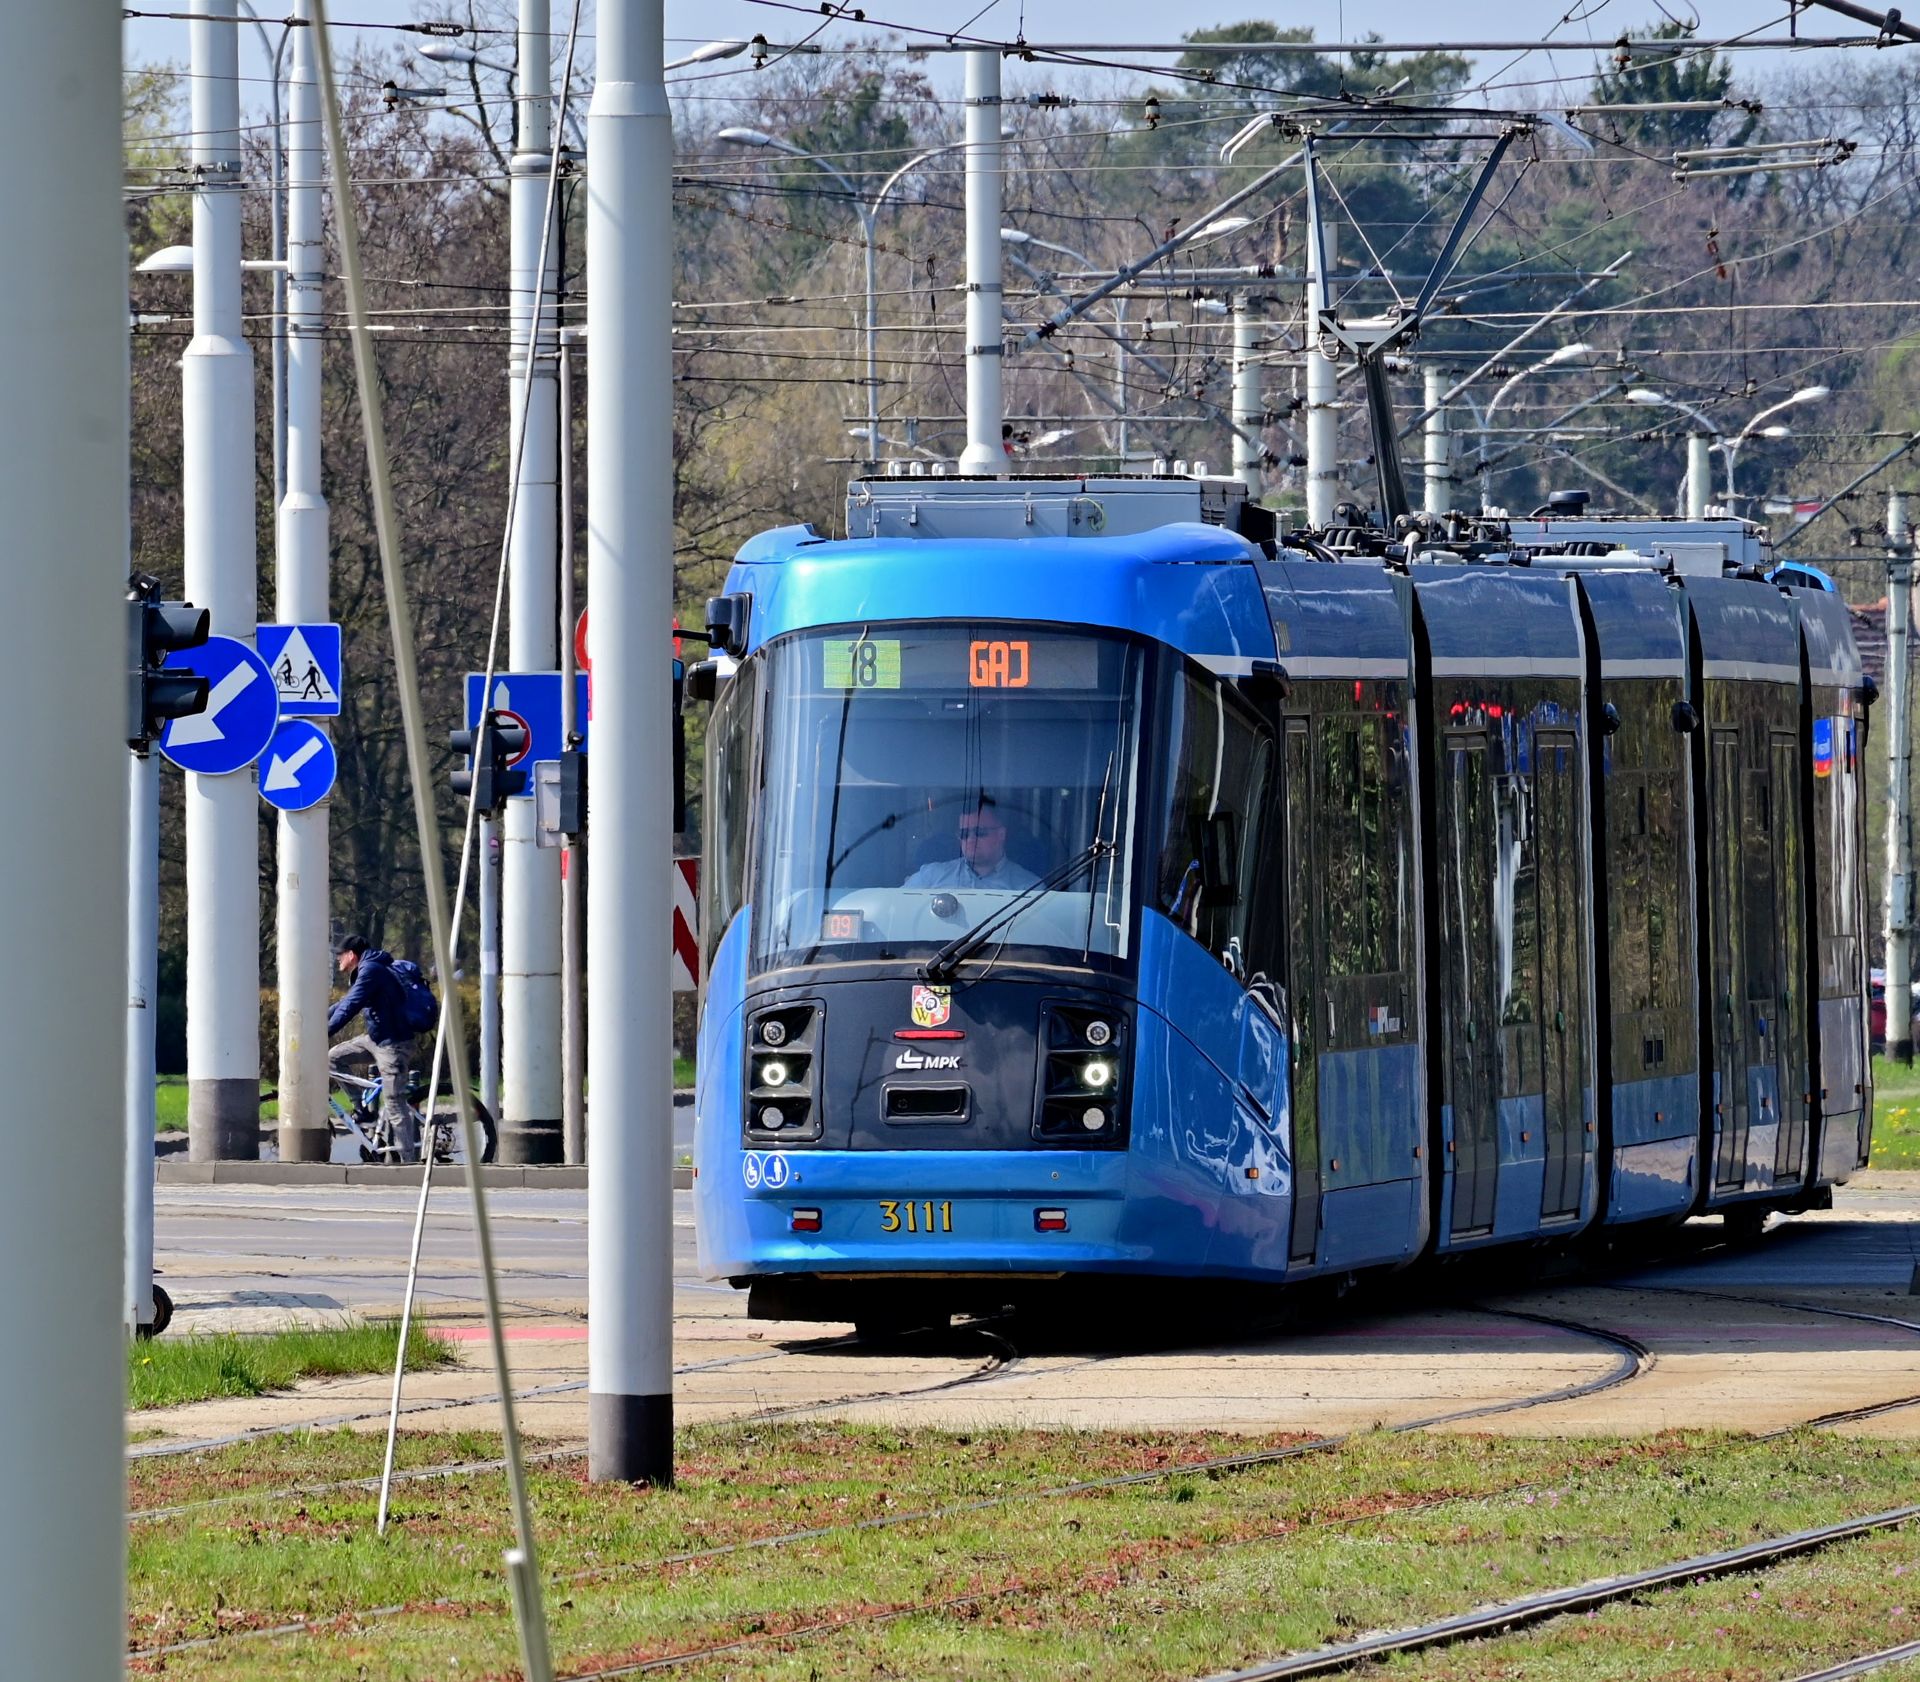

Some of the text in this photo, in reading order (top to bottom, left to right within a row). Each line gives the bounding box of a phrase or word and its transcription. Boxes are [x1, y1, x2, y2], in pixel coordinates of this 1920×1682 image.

[847, 641, 1030, 688] 18 GAJ
[831, 914, 852, 937] 09
[915, 1006, 930, 1022] W
[924, 1055, 961, 1070] MPK
[879, 1200, 953, 1233] 3111
